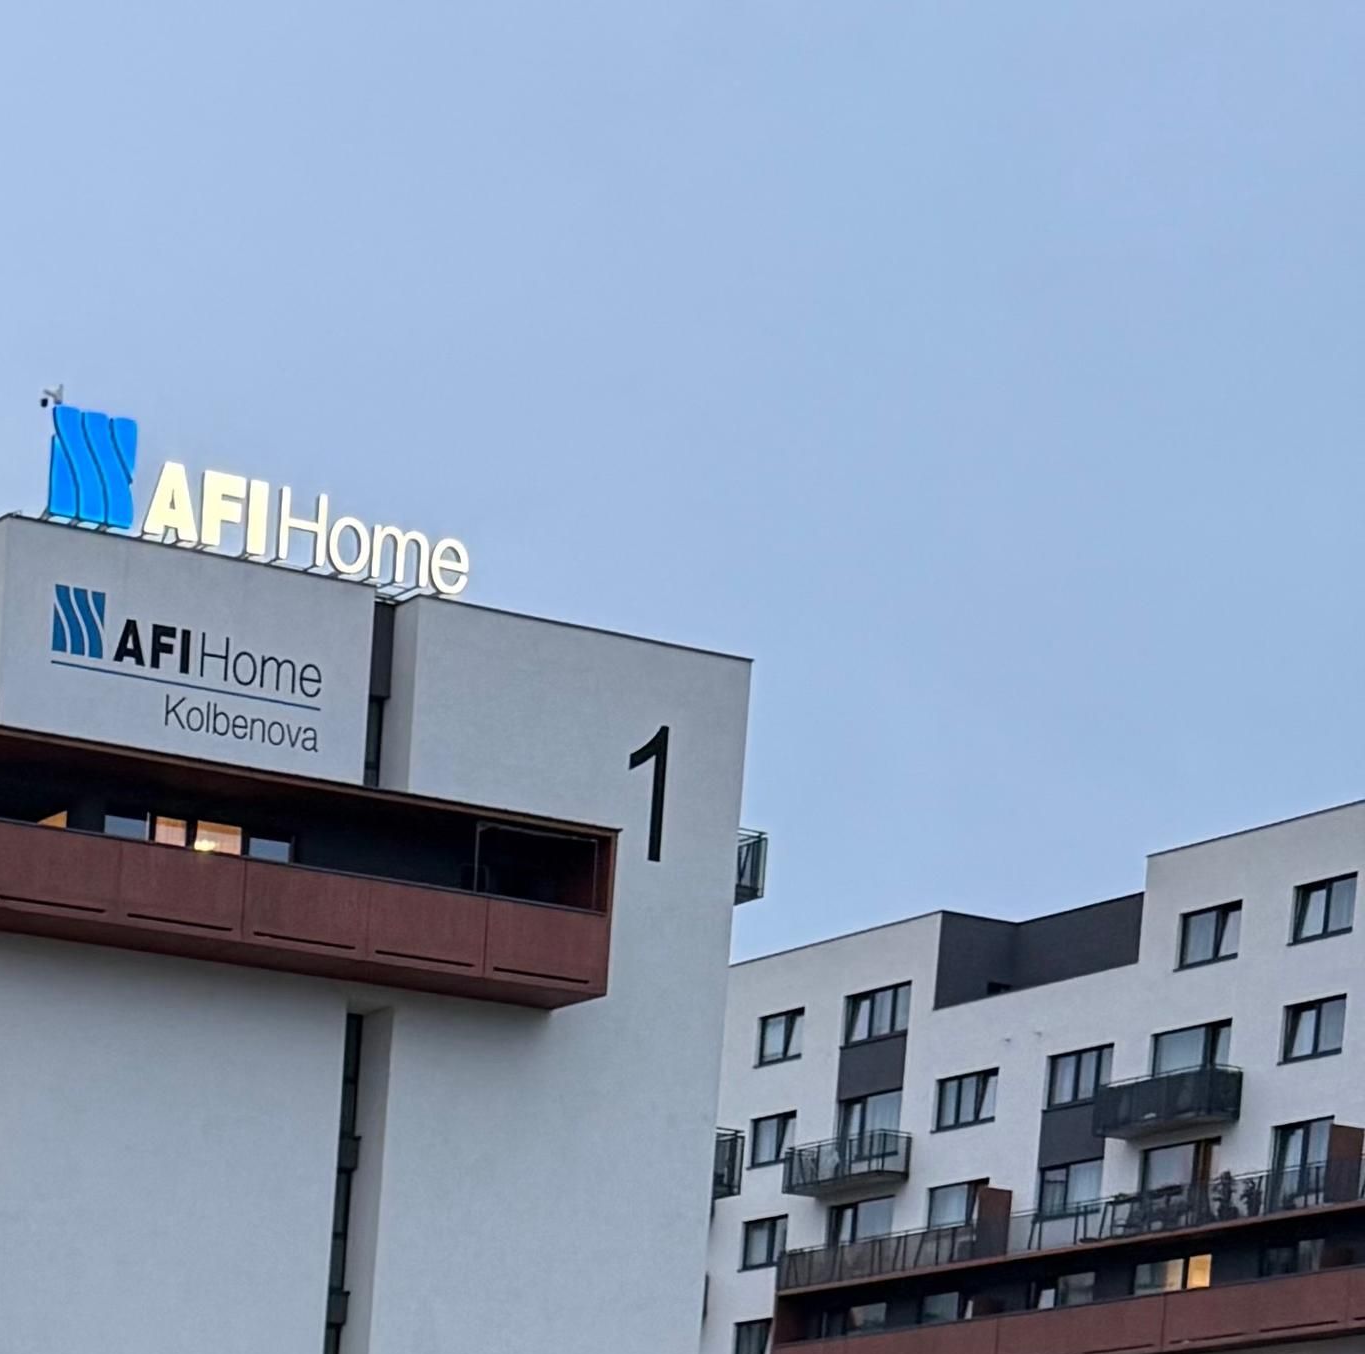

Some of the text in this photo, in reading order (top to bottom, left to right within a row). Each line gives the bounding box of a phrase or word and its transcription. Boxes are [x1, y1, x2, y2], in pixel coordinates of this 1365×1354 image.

[143, 461, 469, 594] AFI Home
[113, 619, 322, 698] AFI Home
[163, 694, 318, 753] Kolbenova
[628, 725, 669, 862] 1
